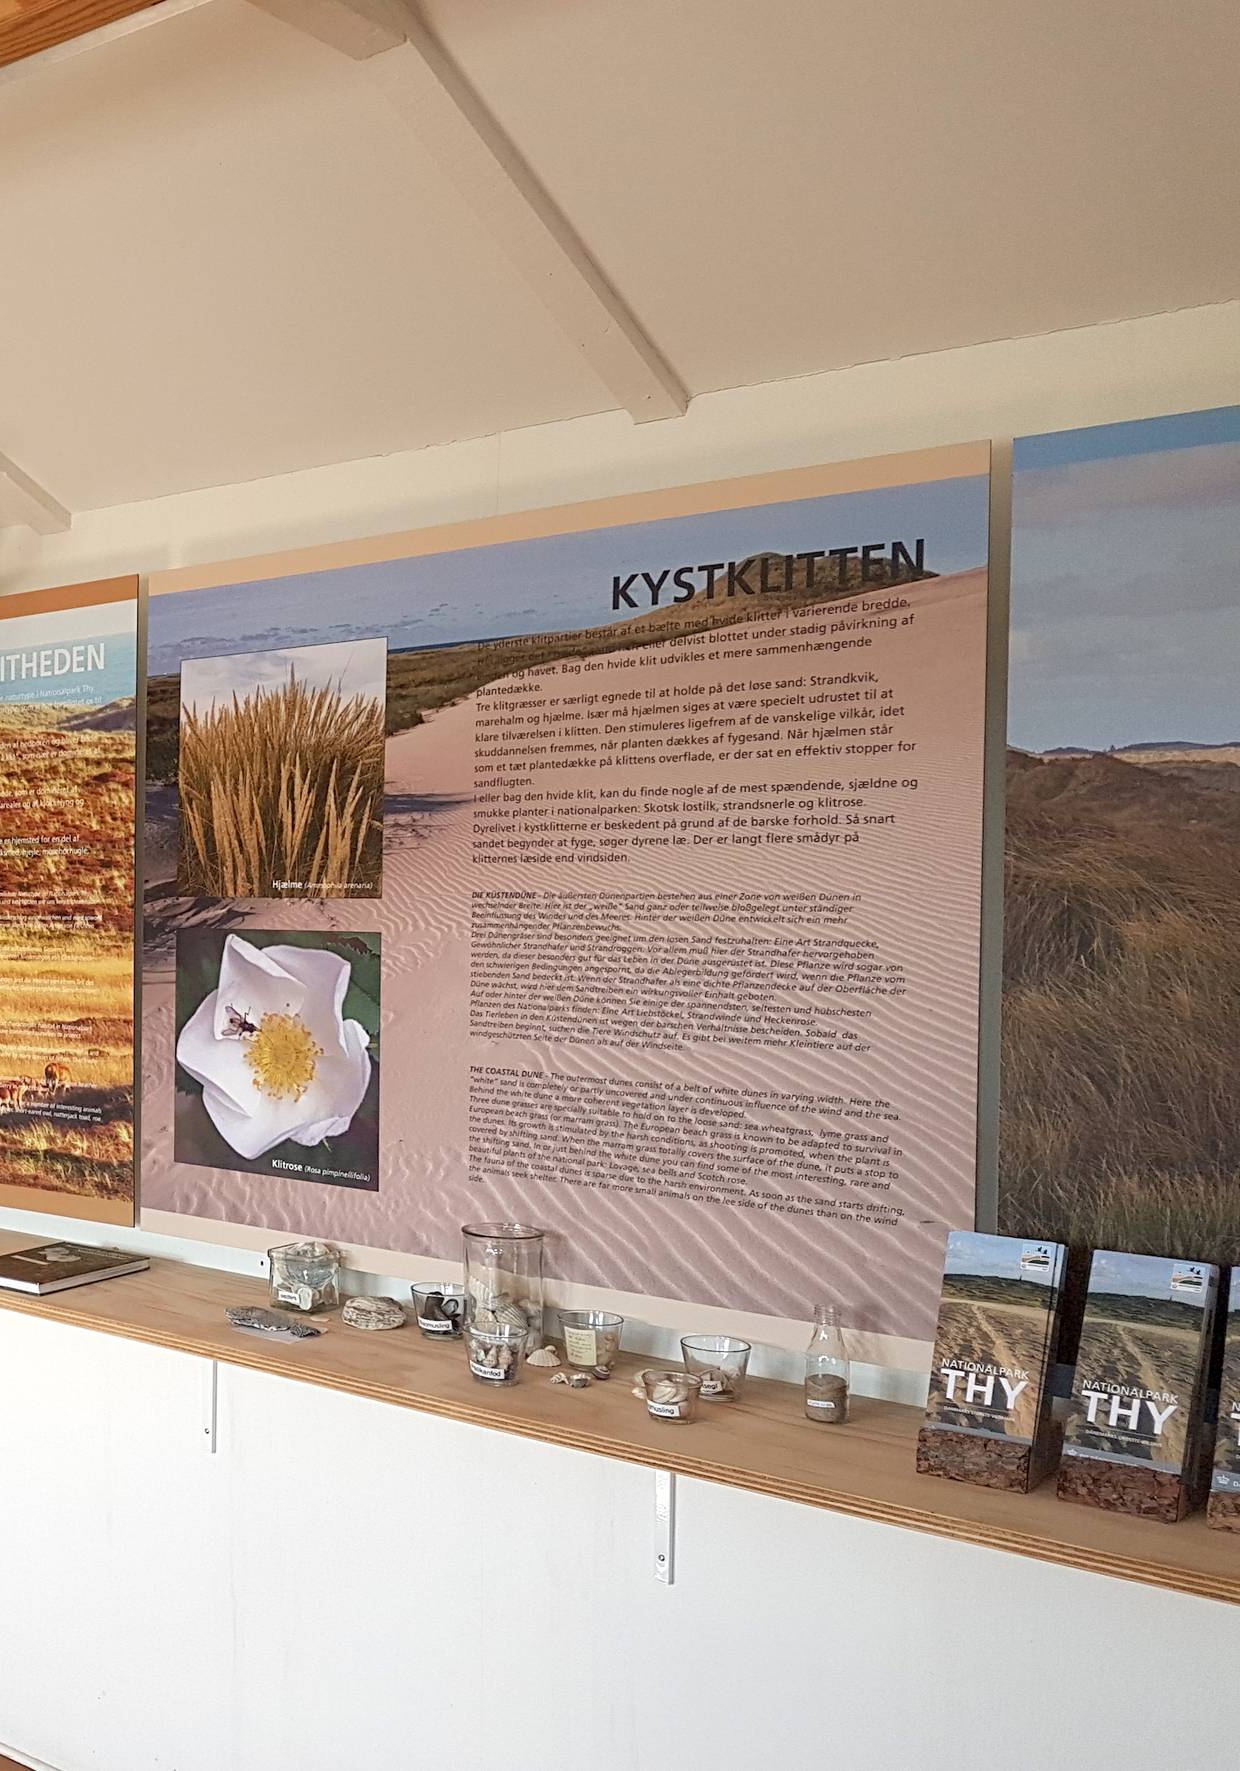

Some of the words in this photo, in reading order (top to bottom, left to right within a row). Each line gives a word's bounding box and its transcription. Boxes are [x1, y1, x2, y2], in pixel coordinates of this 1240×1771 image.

[611, 538, 925, 610] KYSTKLITTEN
[669, 633, 706, 646] delvist
[708, 629, 748, 642] blottet
[751, 626, 786, 638] under
[789, 622, 826, 638] stadig
[830, 615, 897, 634] påvirkning
[900, 614, 913, 624] af
[527, 664, 558, 676] havet.
[561, 662, 581, 676] Bag
[583, 659, 603, 671] den
[606, 656, 636, 669] hvide
[639, 654, 656, 666] klit
[660, 650, 705, 664] udvikles
[708, 649, 719, 659] et
[722, 649, 752, 658] mere
[755, 635, 871, 658] sammenhængende
[475, 681, 542, 698] plantedække.
[476, 701, 490, 711] Tre
[492, 696, 546, 713] klitgræsser
[562, 692, 598, 707] særligt
[601, 688, 641, 704] egnede
[644, 687, 655, 698] til
[658, 686, 669, 696] at
[673, 684, 705, 695] holde
[708, 682, 722, 696] på
[725, 680, 744, 691] det
[748, 678, 771, 690] løse
[774, 676, 806, 688] sand:
[809, 671, 878, 688] Strandkvik,
[474, 731, 499, 742] klare
[501, 727, 555, 740] tilværelsen
[558, 726, 561, 736] i
[564, 724, 602, 736] klitten.
[602, 722, 626, 733] Den
[628, 718, 685, 731] stimuleres
[687, 715, 735, 730] ligefrem
[739, 714, 751, 724] af
[754, 713, 769, 723] de
[772, 709, 835, 725] vanskelige
[839, 707, 875, 721] vilkår,
[879, 705, 904, 716] idet
[475, 713, 524, 727] marehalm
[526, 715, 540, 726] og
[542, 709, 583, 724] hjælme.
[586, 707, 608, 718] Især
[611, 706, 628, 716] må
[631, 702, 679, 718] hjælmen
[682, 700, 710, 714] siges
[712, 699, 724, 709] at
[727, 700, 756, 708] være
[759, 693, 804, 709] specielt
[808, 690, 860, 703] udrustet
[863, 689, 876, 699] til
[880, 688, 893, 698] at
[474, 743, 546, 757] skuddannelsen
[550, 740, 596, 755] fremmes,
[600, 739, 618, 749] når
[620, 736, 663, 751] planten
[665, 733, 708, 745] dækkes
[712, 733, 723, 743] af
[727, 729, 783, 745] fygesand.
[786, 728, 808, 738] Når
[811, 725, 866, 740] hjælmen
[869, 723, 892, 734] står
[473, 775, 534, 790] sandflugten.
[473, 807, 510, 817] smukke
[512, 805, 549, 819] planter
[550, 805, 554, 815] i
[556, 802, 641, 818] nationalparken:
[643, 801, 679, 812] Skotsk
[682, 800, 719, 814] lostilk,
[722, 798, 796, 809] strandsnerle
[797, 800, 815, 810] og
[818, 796, 867, 807] klitrose.
[272, 880, 303, 891] Hjælme
[469, 1064, 484, 1073] THE
[484, 1065, 519, 1076] COASTAL
[520, 1068, 544, 1078] DUNE
[550, 1071, 564, 1080] The
[565, 1072, 607, 1084] outermost
[608, 1076, 633, 1086] dunes
[634, 1079, 662, 1089] consist
[683, 1083, 700, 1092] belt
[714, 1085, 739, 1095] white
[740, 1088, 768, 1098] dunes
[780, 1091, 814, 1103] varying
[849, 1096, 872, 1106] Here
[874, 1098, 890, 1107] the
[272, 1159, 303, 1172] Klitrose
[304, 1165, 321, 1175] (Rosa
[941, 1358, 1030, 1380] NATIONALPARK
[941, 1368, 1029, 1410] THY
[1082, 1380, 1179, 1404] NATIONALPARK
[1081, 1390, 1178, 1435] THY
